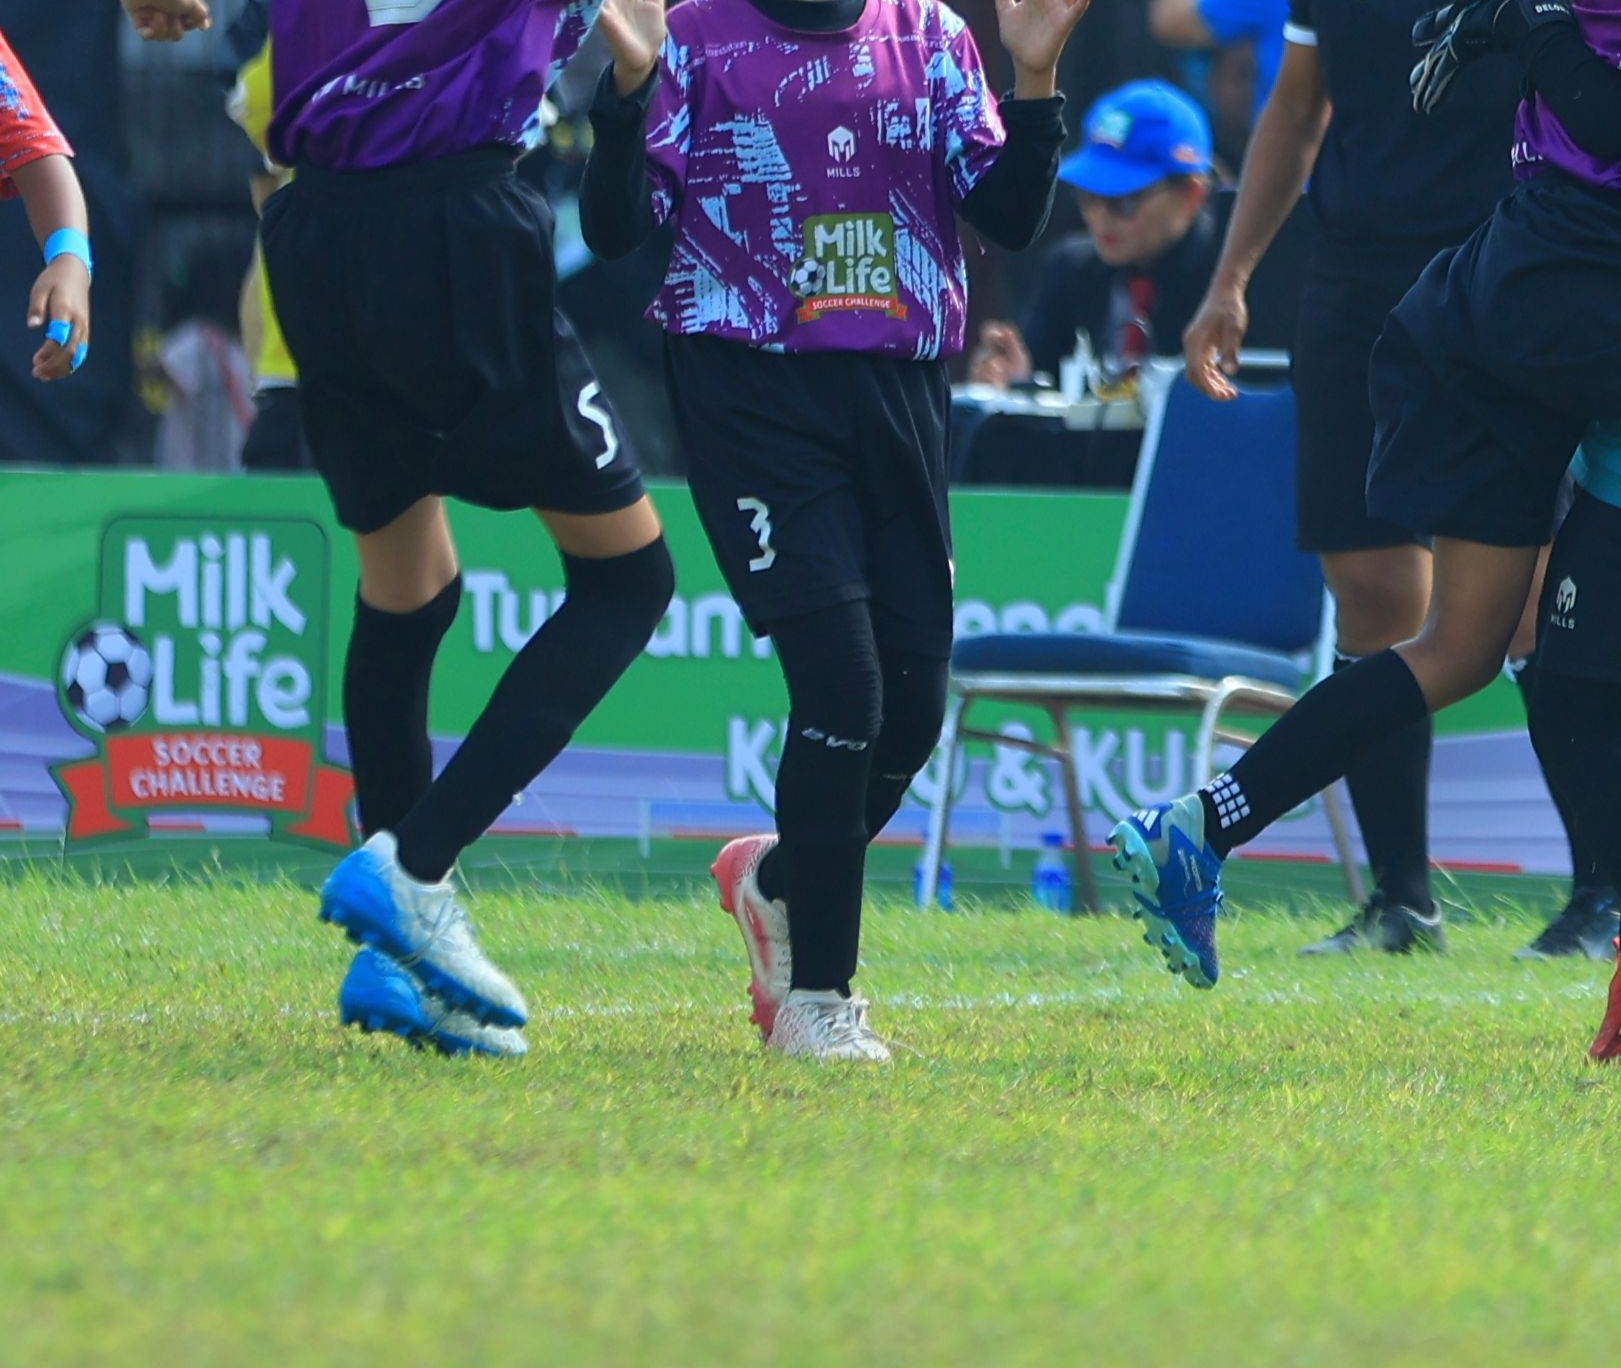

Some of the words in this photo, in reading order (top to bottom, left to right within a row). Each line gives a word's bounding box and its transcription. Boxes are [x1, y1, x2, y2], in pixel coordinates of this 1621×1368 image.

[826, 166, 861, 179] MILLS
[814, 219, 887, 258] Milk
[826, 256, 892, 295] Life
[812, 298, 844, 311] SOCCER
[845, 296, 892, 310] CHALLENGE
[577, 380, 619, 470] 5
[737, 497, 777, 572] 3
[124, 528, 308, 636] Milk
[152, 626, 312, 730] Life
[152, 737, 262, 770] SOCCER
[993, 722, 1048, 814] &
[129, 769, 286, 803] CHALLENGE
